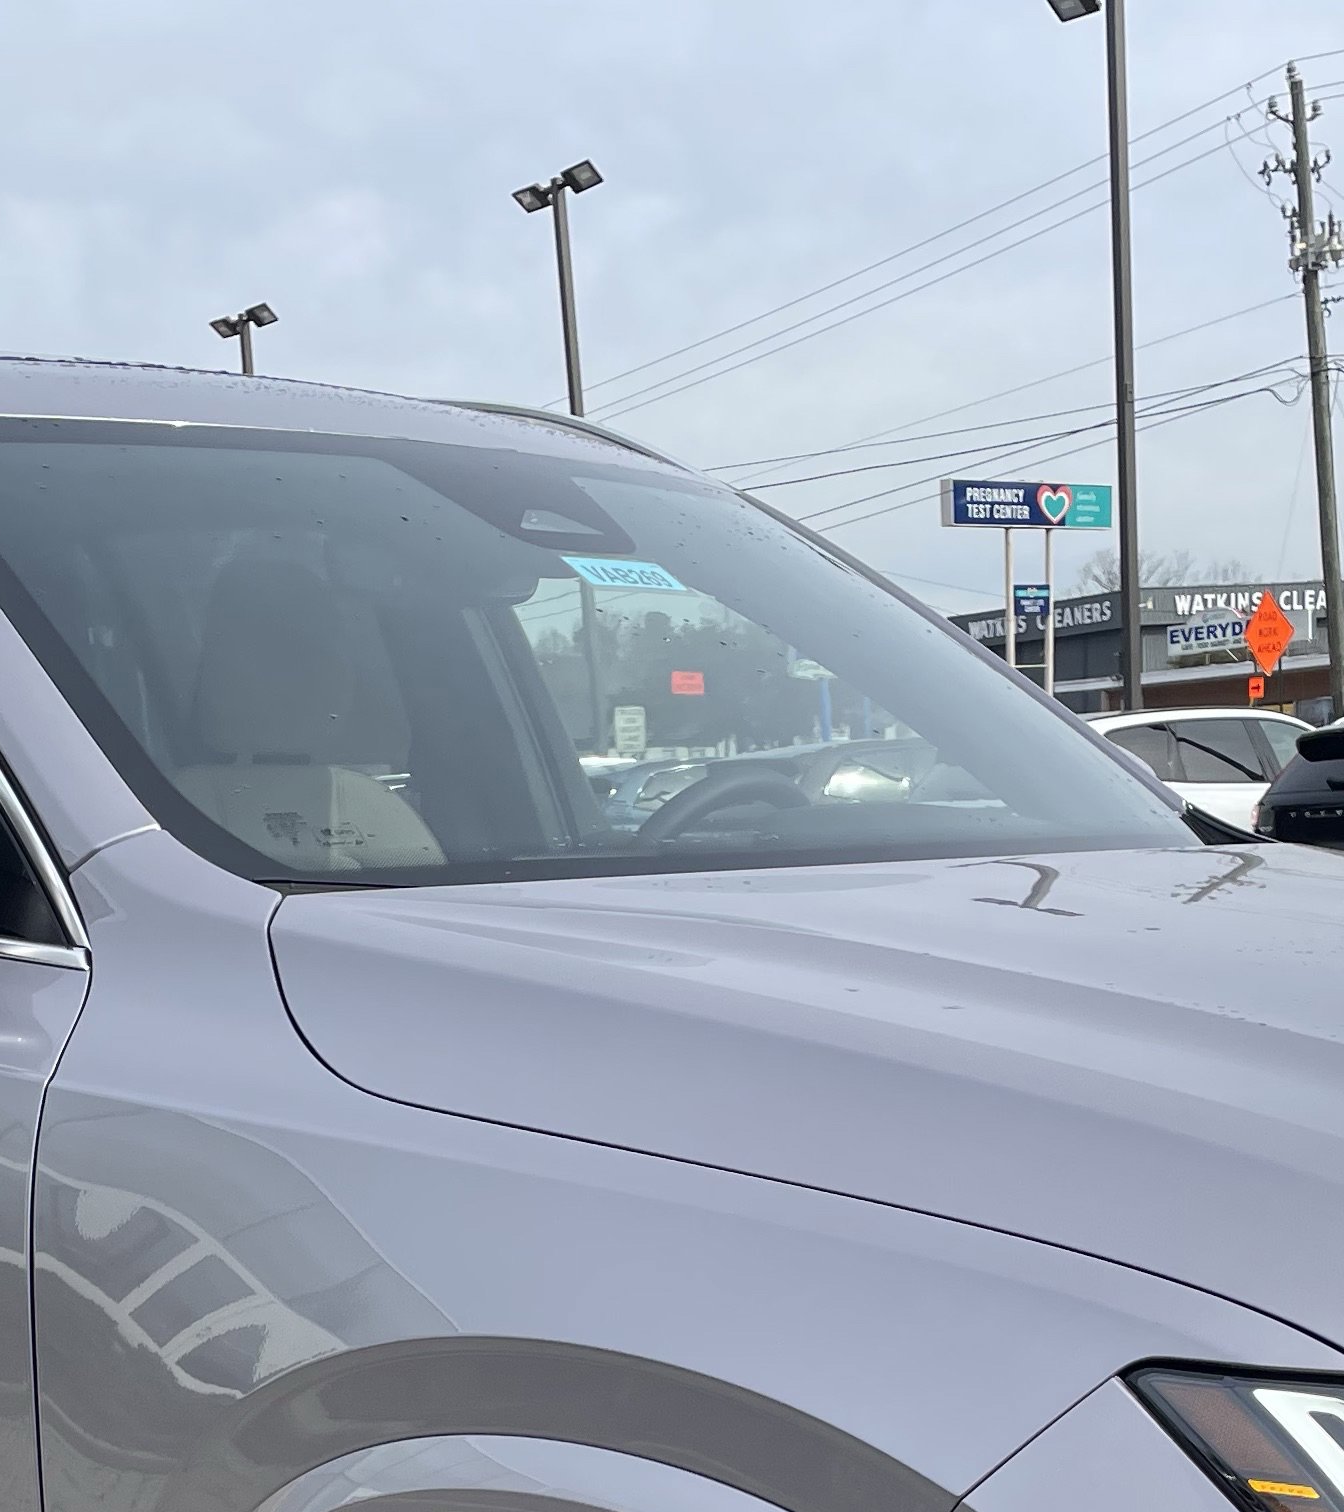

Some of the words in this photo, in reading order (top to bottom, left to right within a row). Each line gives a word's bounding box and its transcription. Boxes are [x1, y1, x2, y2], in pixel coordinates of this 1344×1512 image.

[965, 487, 1025, 503] PREGNANCY
[967, 504, 993, 519] TEST
[993, 504, 1030, 519] CENTER
[580, 564, 673, 588] VAB269
[1174, 591, 1263, 616] WATKINS
[968, 614, 1027, 640] WATKS
[1036, 601, 1112, 631] CEANERS
[1170, 619, 1253, 644] EVERYD
[1257, 641, 1282, 653] AHEAD
